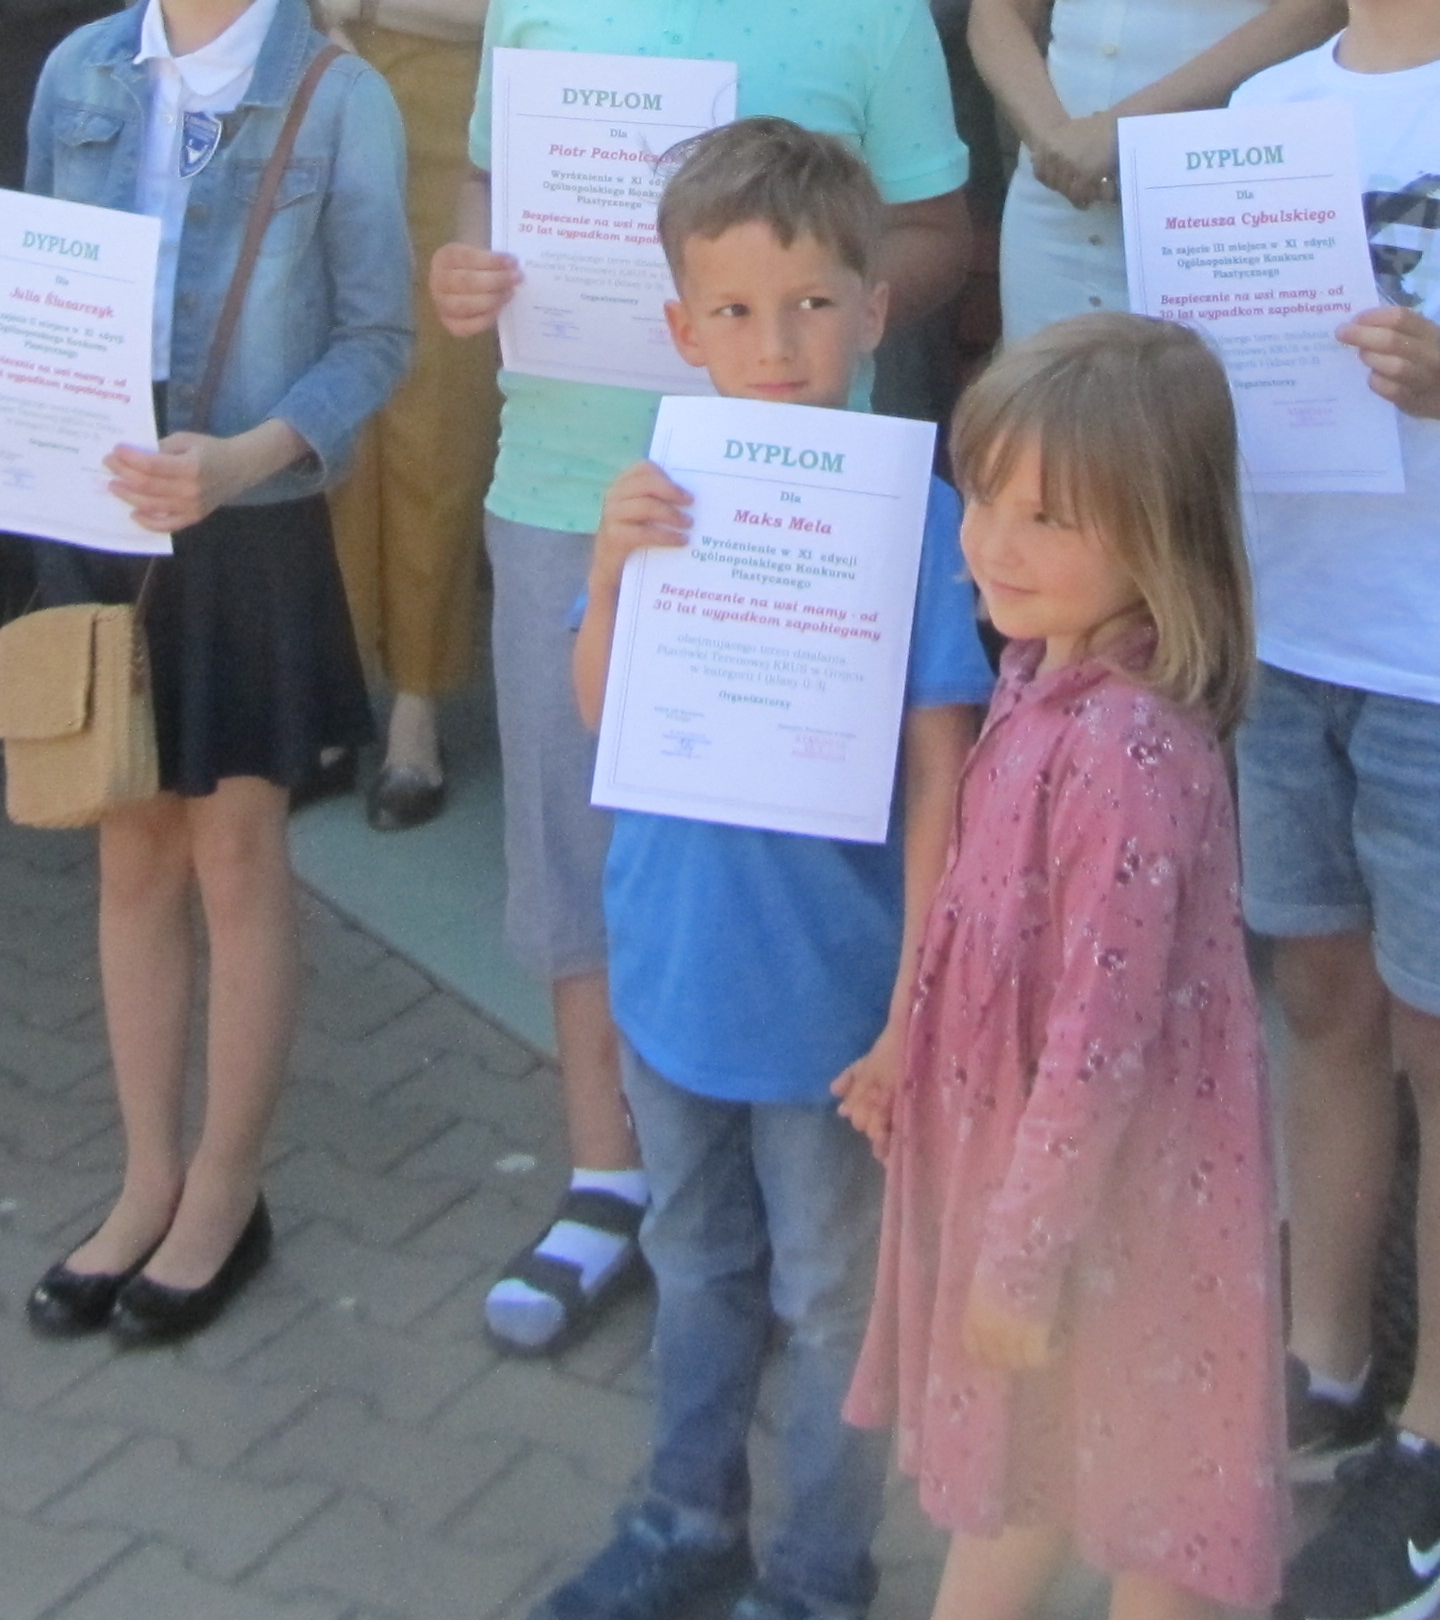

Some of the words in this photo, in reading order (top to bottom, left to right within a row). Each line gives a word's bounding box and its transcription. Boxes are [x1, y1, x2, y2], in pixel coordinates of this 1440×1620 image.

[562, 87, 662, 111] DYPLOM
[610, 129, 628, 138] Dla
[548, 144, 587, 157] Piotr
[1185, 145, 1284, 170] DYPLOM
[1236, 190, 1254, 200] Dla
[522, 210, 590, 225] Bezpiecznie
[594, 219, 609, 227] na
[613, 219, 633, 229] wsi
[1165, 215, 1235, 230] Mateusza
[1241, 208, 1336, 228] Cybulskiego
[518, 223, 533, 233] 30
[537, 225, 553, 235] lat
[557, 228, 620, 241] wypadkom
[22, 230, 101, 261] DYPLOM
[1228, 241, 1267, 253] miejsca
[1285, 239, 1297, 248] XI
[1304, 236, 1336, 249] edycji
[1177, 255, 1260, 270] Ogólnopolskiego
[1263, 252, 1315, 263] Konkursu
[1213, 267, 1280, 280] Plastycznego
[1161, 293, 1230, 307] Bezpiecznie
[1234, 293, 1250, 301] na
[1254, 290, 1274, 300] wsi
[1279, 288, 1317, 300] mamy
[1327, 285, 1344, 296] od
[1177, 308, 1194, 319] lat
[1198, 306, 1265, 320] wypadkom
[1268, 302, 1352, 318] zapobiegamy
[724, 439, 846, 473] DYPLOM
[780, 491, 801, 504] Dla
[734, 509, 782, 528] Maks
[788, 516, 832, 534] Mela
[701, 535, 776, 556] Wyróżnienie
[781, 548, 791, 556] w
[798, 549, 812, 560] XI
[820, 552, 857, 568] edycji
[691, 549, 791, 573] Ogólnopolskiego
[796, 563, 855, 580] Konkursu
[731, 568, 811, 590] Plastycznego
[660, 583, 745, 605] Bezpiecznie
[750, 598, 768, 608] na
[774, 600, 798, 612] wsi
[803, 605, 847, 621] mamy
[860, 611, 879, 623] od
[653, 599, 672, 611] 30
[677, 602, 696, 615] lat
[702, 607, 780, 627] wypadkom
[785, 617, 882, 642] zapobiegamy
